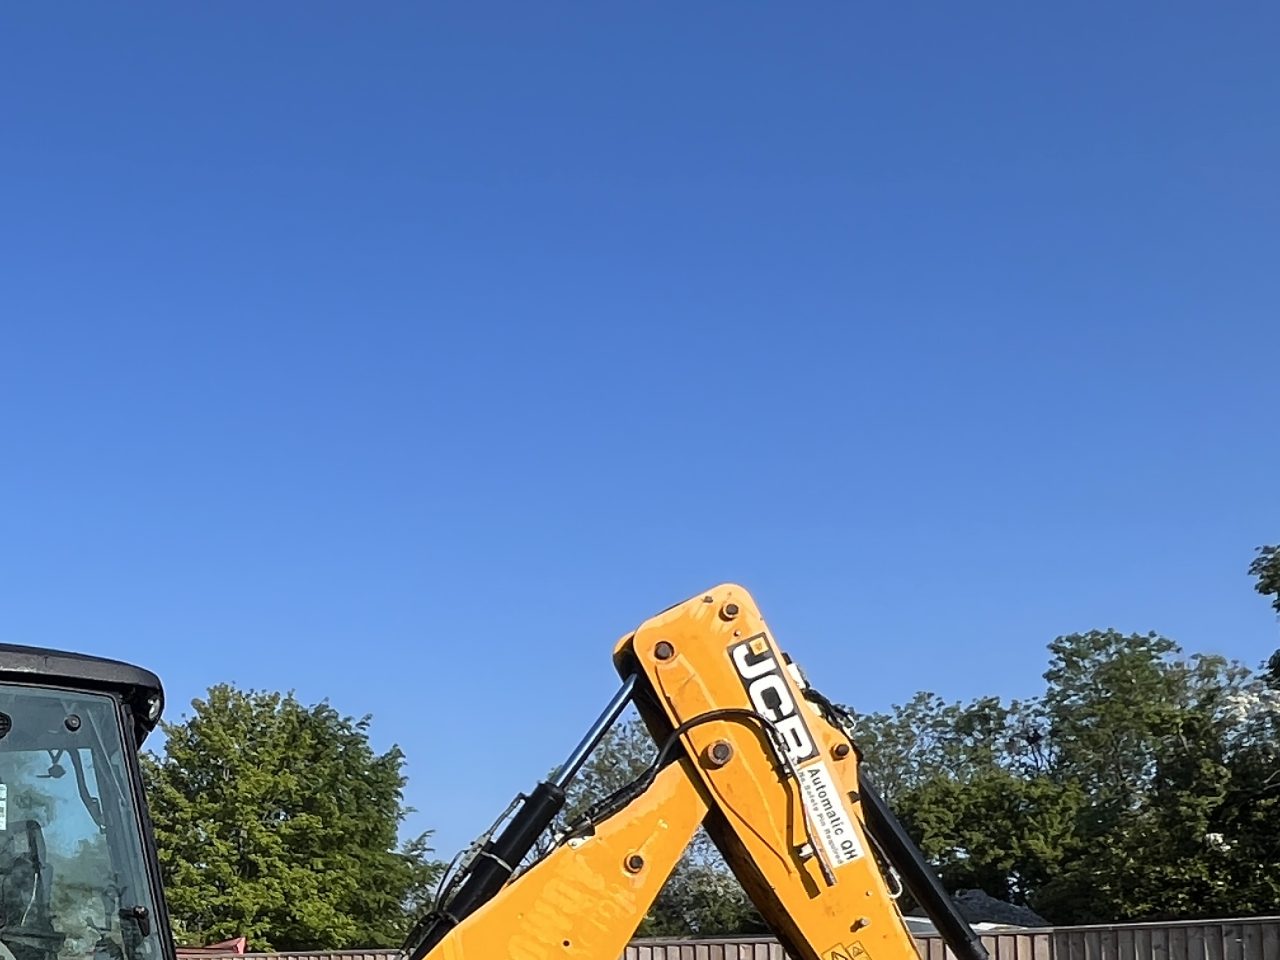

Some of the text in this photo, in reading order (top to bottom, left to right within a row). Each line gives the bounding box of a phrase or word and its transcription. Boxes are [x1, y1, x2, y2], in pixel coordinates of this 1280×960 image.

[732, 643, 814, 770] JCB
[804, 784, 820, 812] Safety
[817, 813, 826, 827] Pin
[824, 828, 844, 865] Required
[808, 768, 858, 860] Automatic QH
